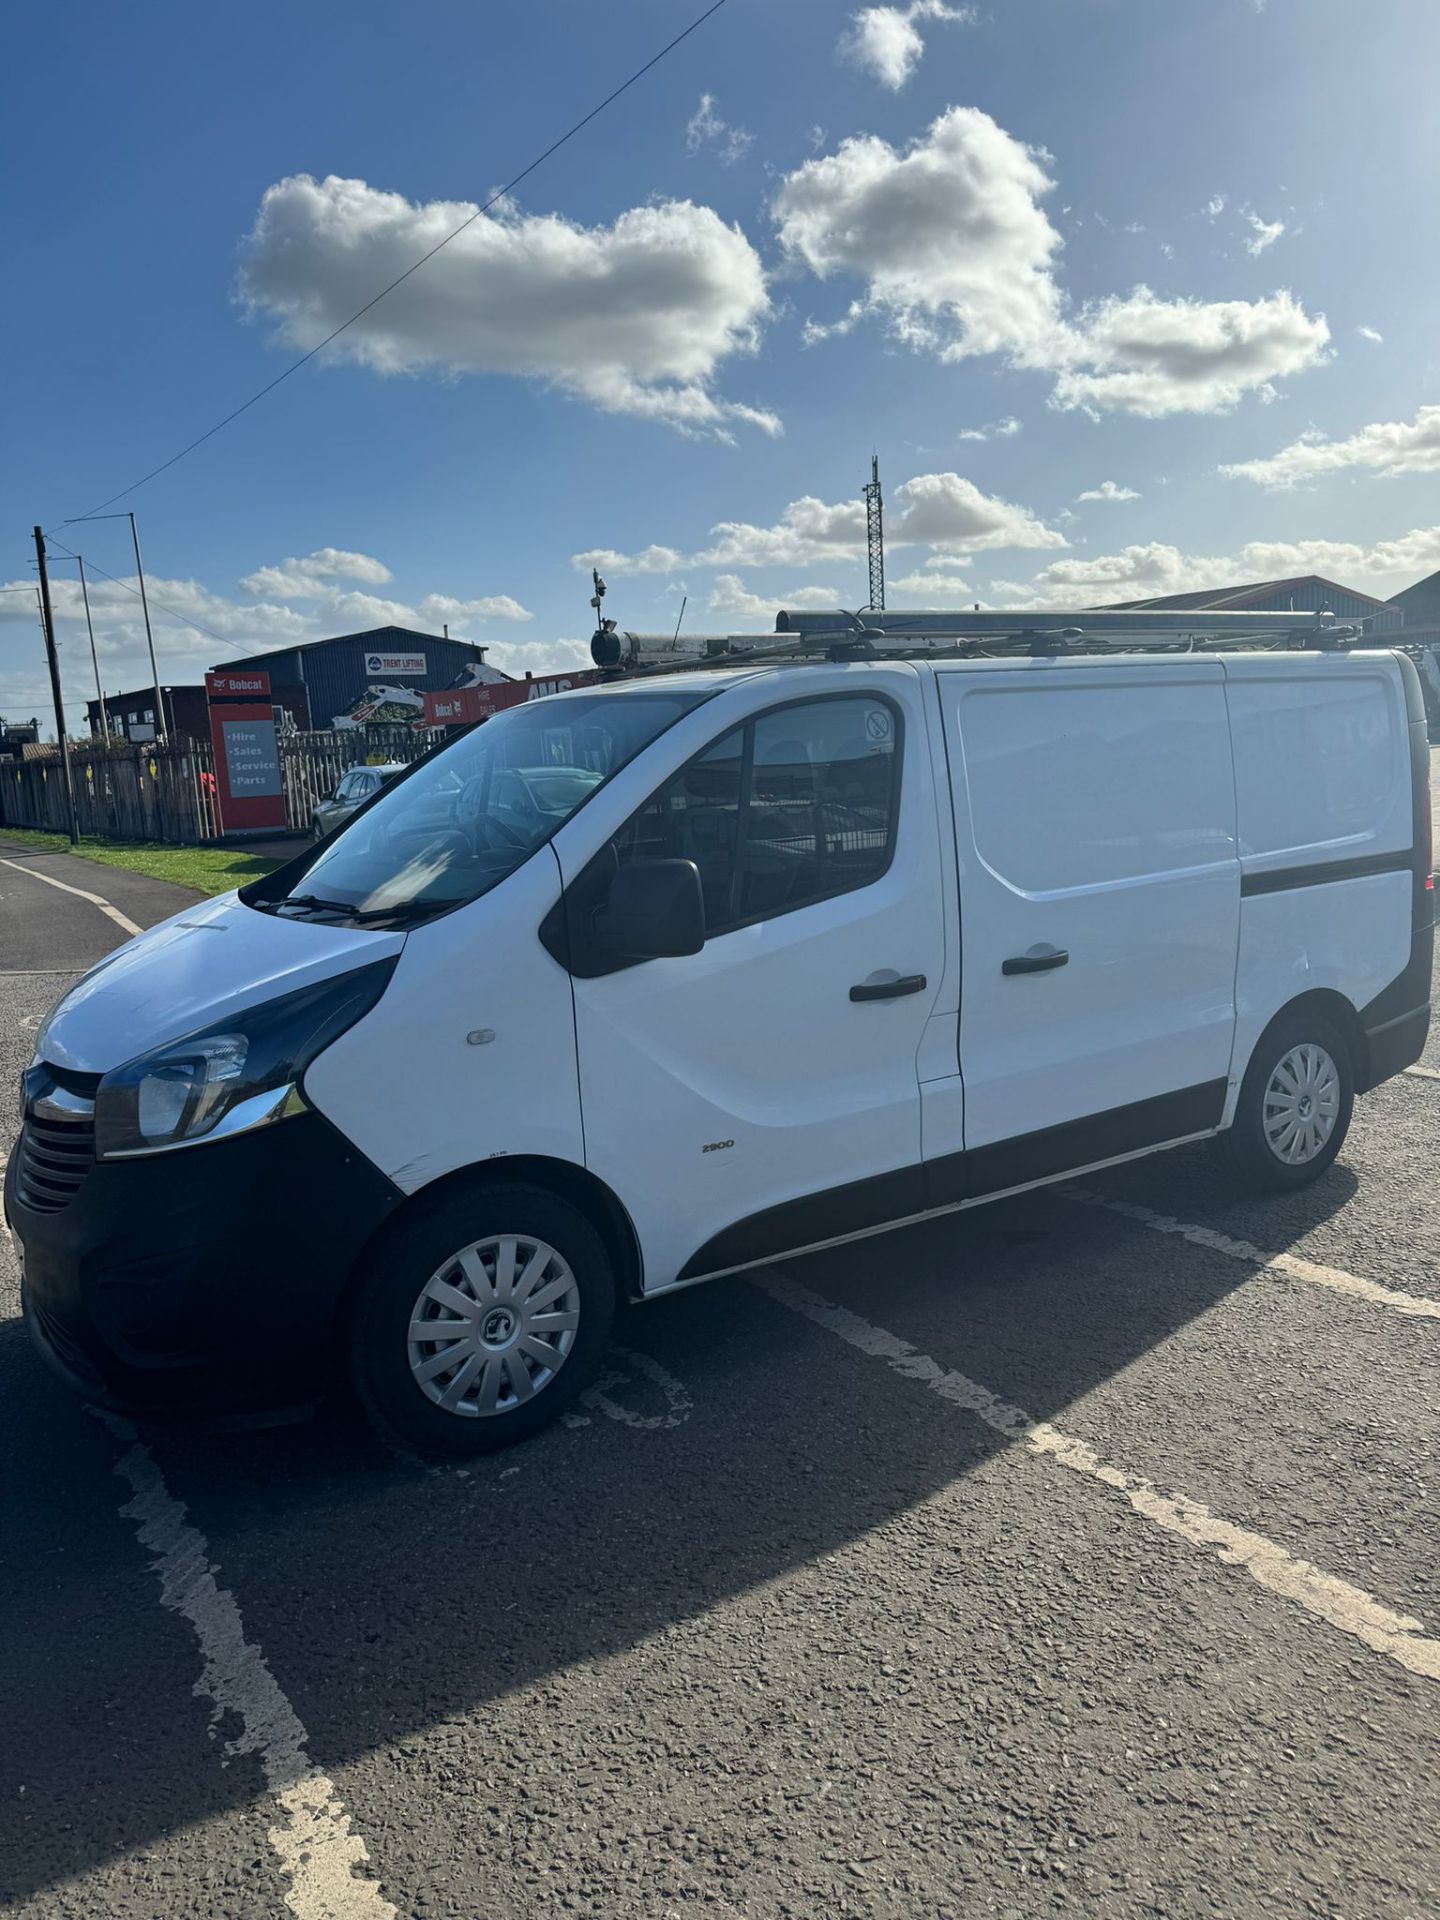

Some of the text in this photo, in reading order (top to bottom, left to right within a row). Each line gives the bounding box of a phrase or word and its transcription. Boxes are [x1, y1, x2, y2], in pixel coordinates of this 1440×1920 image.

[383, 659, 425, 668] TRENT LIFTING
[229, 679, 262, 690] Bobcat
[232, 732, 256, 742] Hire
[234, 747, 262, 756] Sales
[235, 761, 275, 771] Service
[237, 776, 266, 785] Parts
[702, 1139, 735, 1153] 2900
